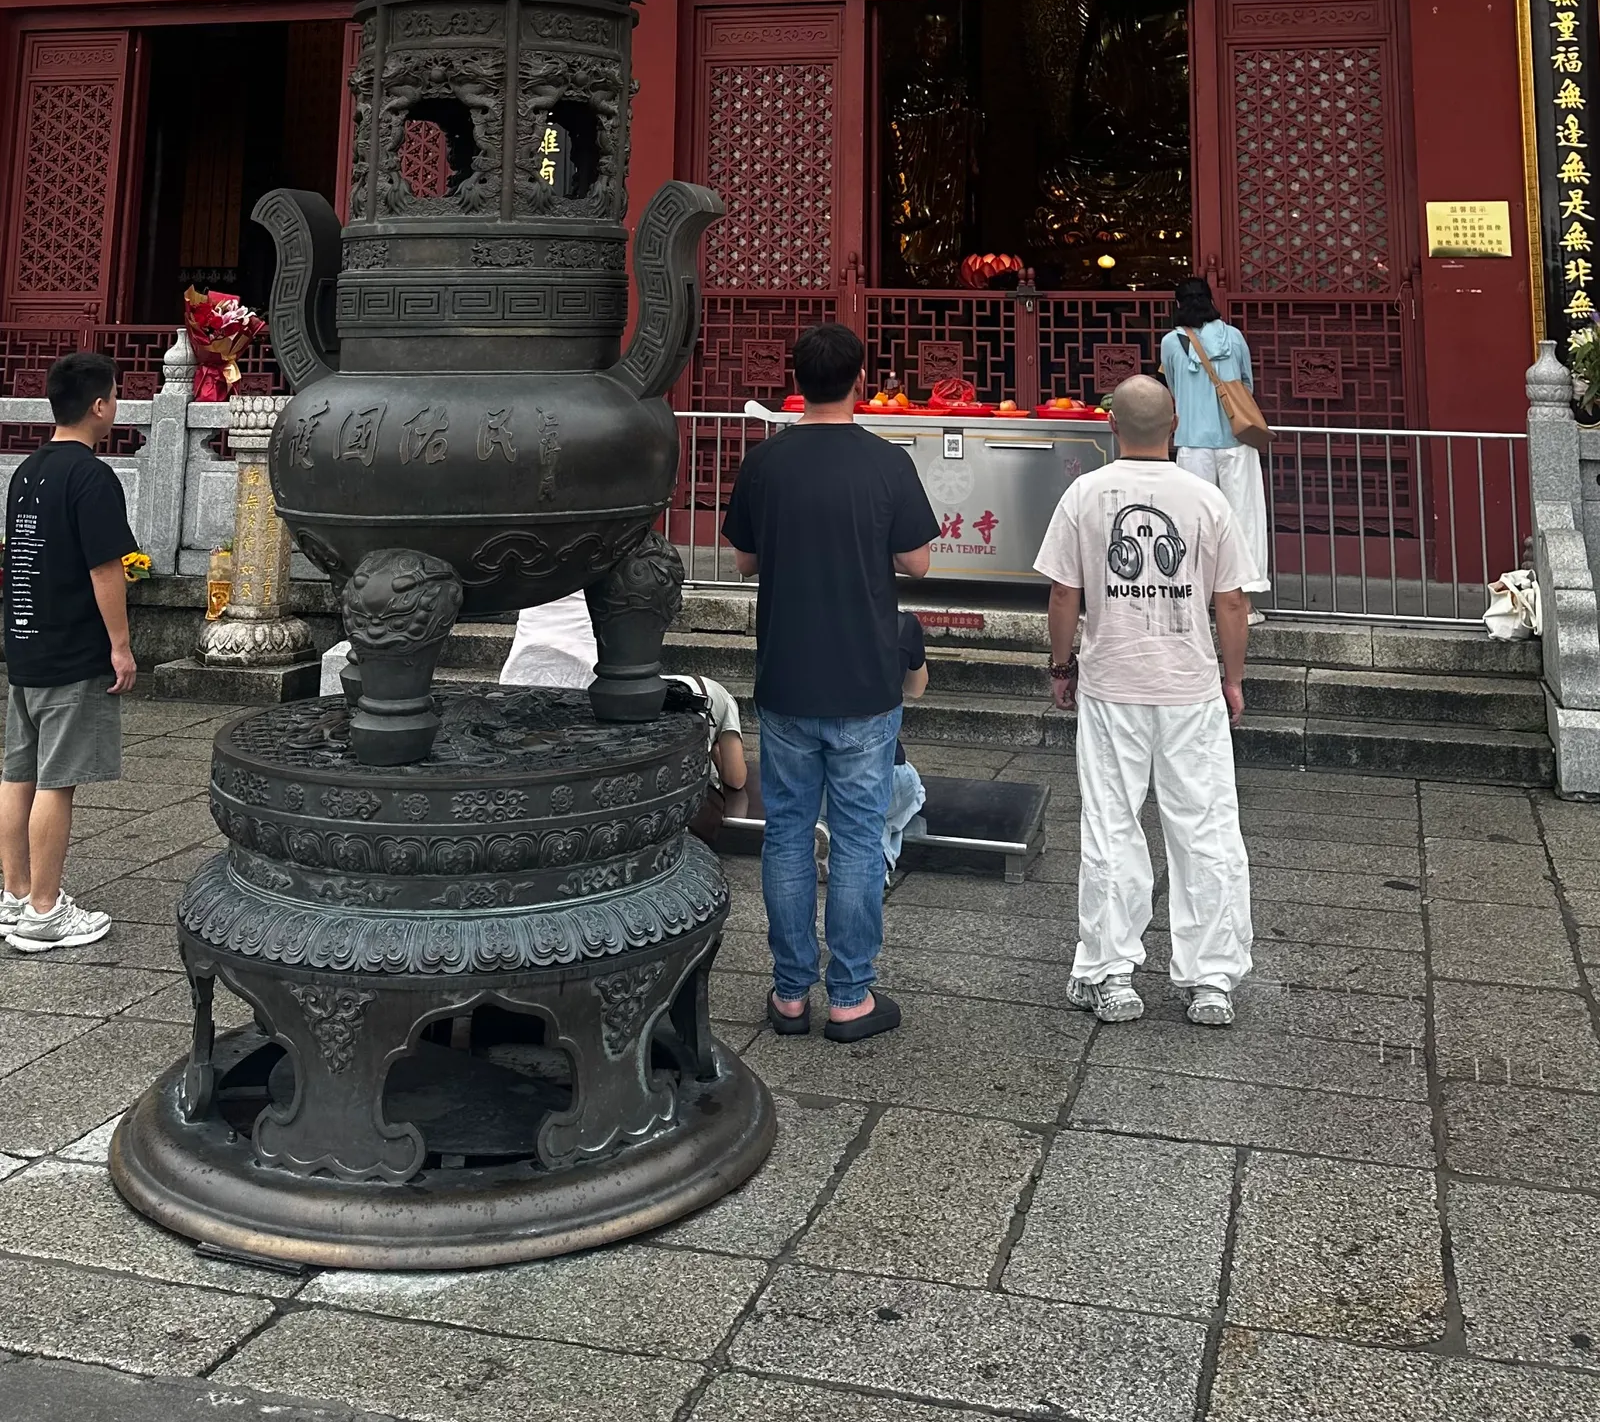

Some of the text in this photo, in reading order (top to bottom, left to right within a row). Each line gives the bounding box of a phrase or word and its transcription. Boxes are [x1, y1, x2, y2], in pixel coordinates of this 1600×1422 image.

[940, 510, 999, 544] 法寺
[940, 543, 954, 553] FA
[955, 544, 997, 555] TEMPLE
[1107, 584, 1193, 599] MUSIC TIME
